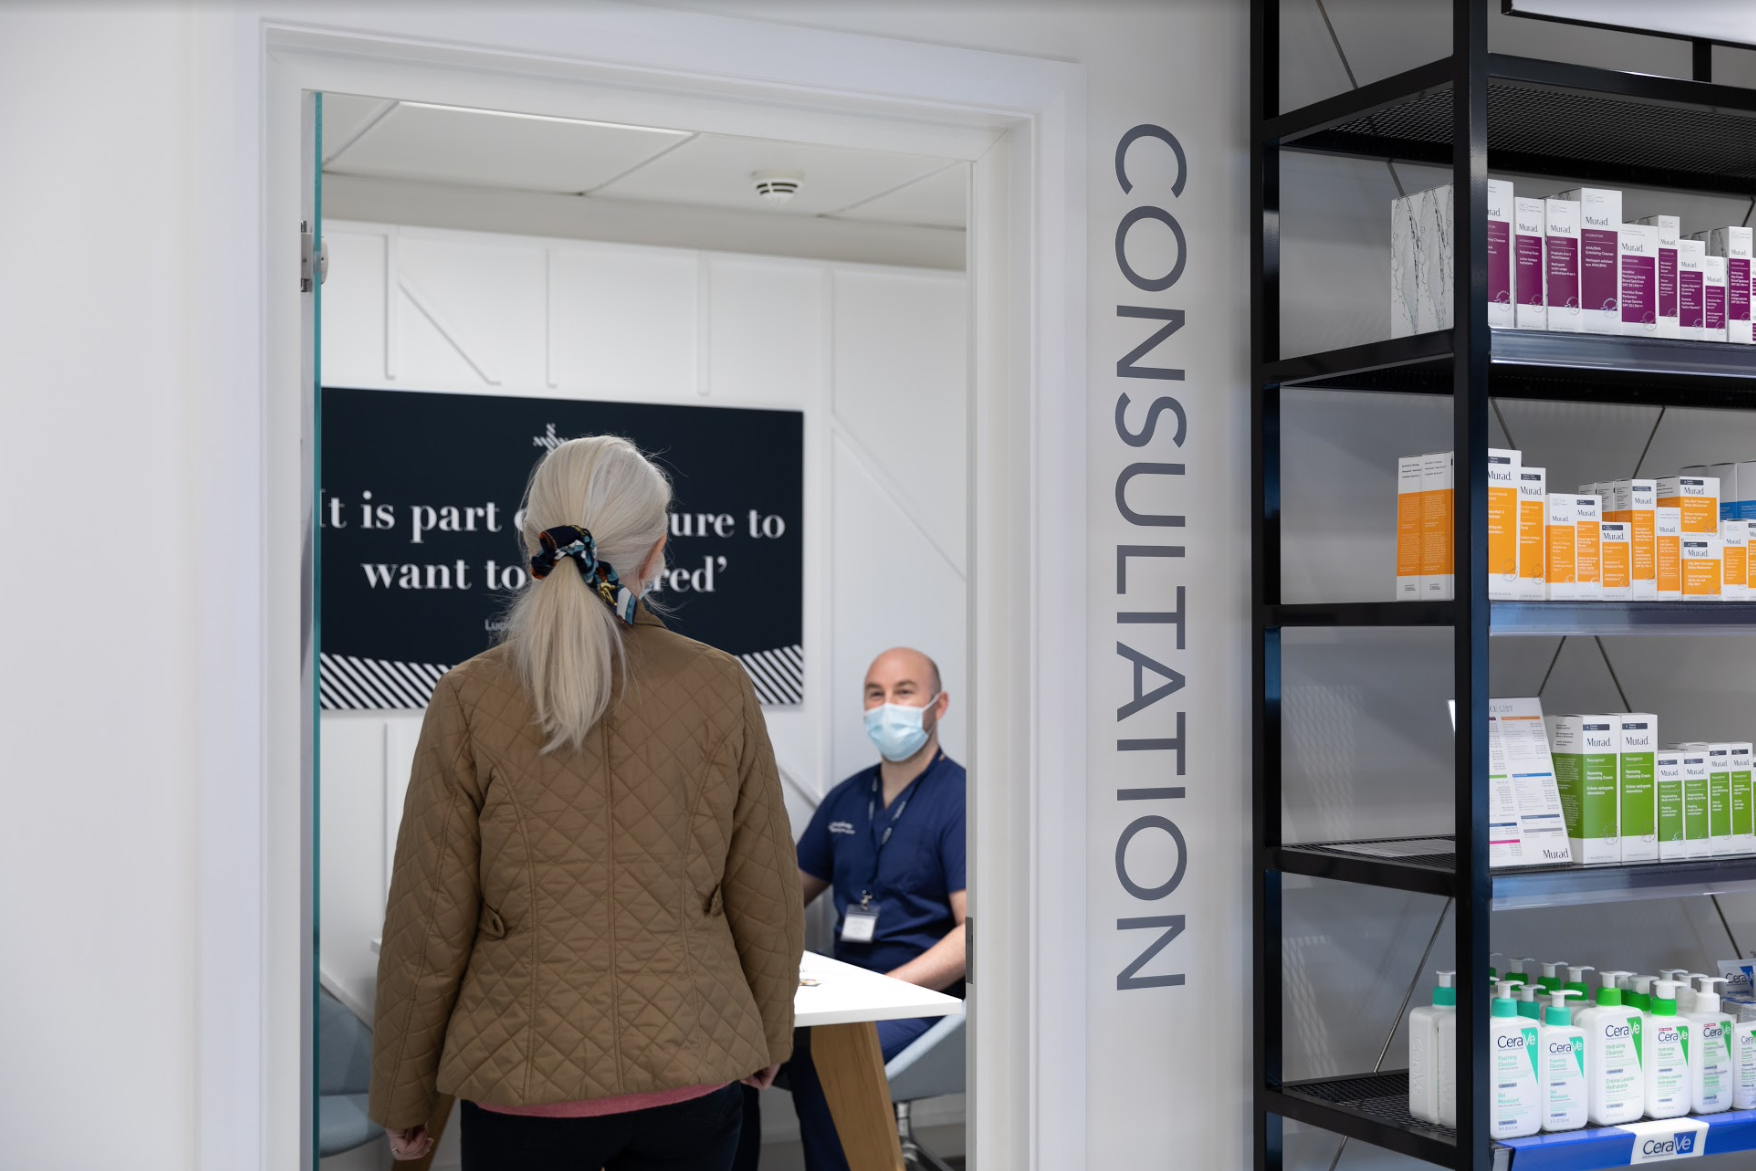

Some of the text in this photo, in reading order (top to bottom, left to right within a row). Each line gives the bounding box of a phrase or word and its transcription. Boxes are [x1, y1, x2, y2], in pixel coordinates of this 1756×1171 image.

[361, 490, 395, 530] is
[410, 502, 502, 543] part
[670, 513, 735, 538] ure
[747, 509, 786, 539] to
[1115, 124, 1187, 991] CONSULTATION
[361, 560, 472, 590] want
[484, 560, 527, 590] to
[1605, 1022, 1640, 1037] CeraVe
[1658, 1030, 1689, 1042] CeraVe
[1703, 1025, 1731, 1038] CeraVe
[1498, 1032, 1536, 1048] CeraVe
[1549, 1040, 1583, 1054] CeraVe
[1643, 1136, 1691, 1155] CeraVe
